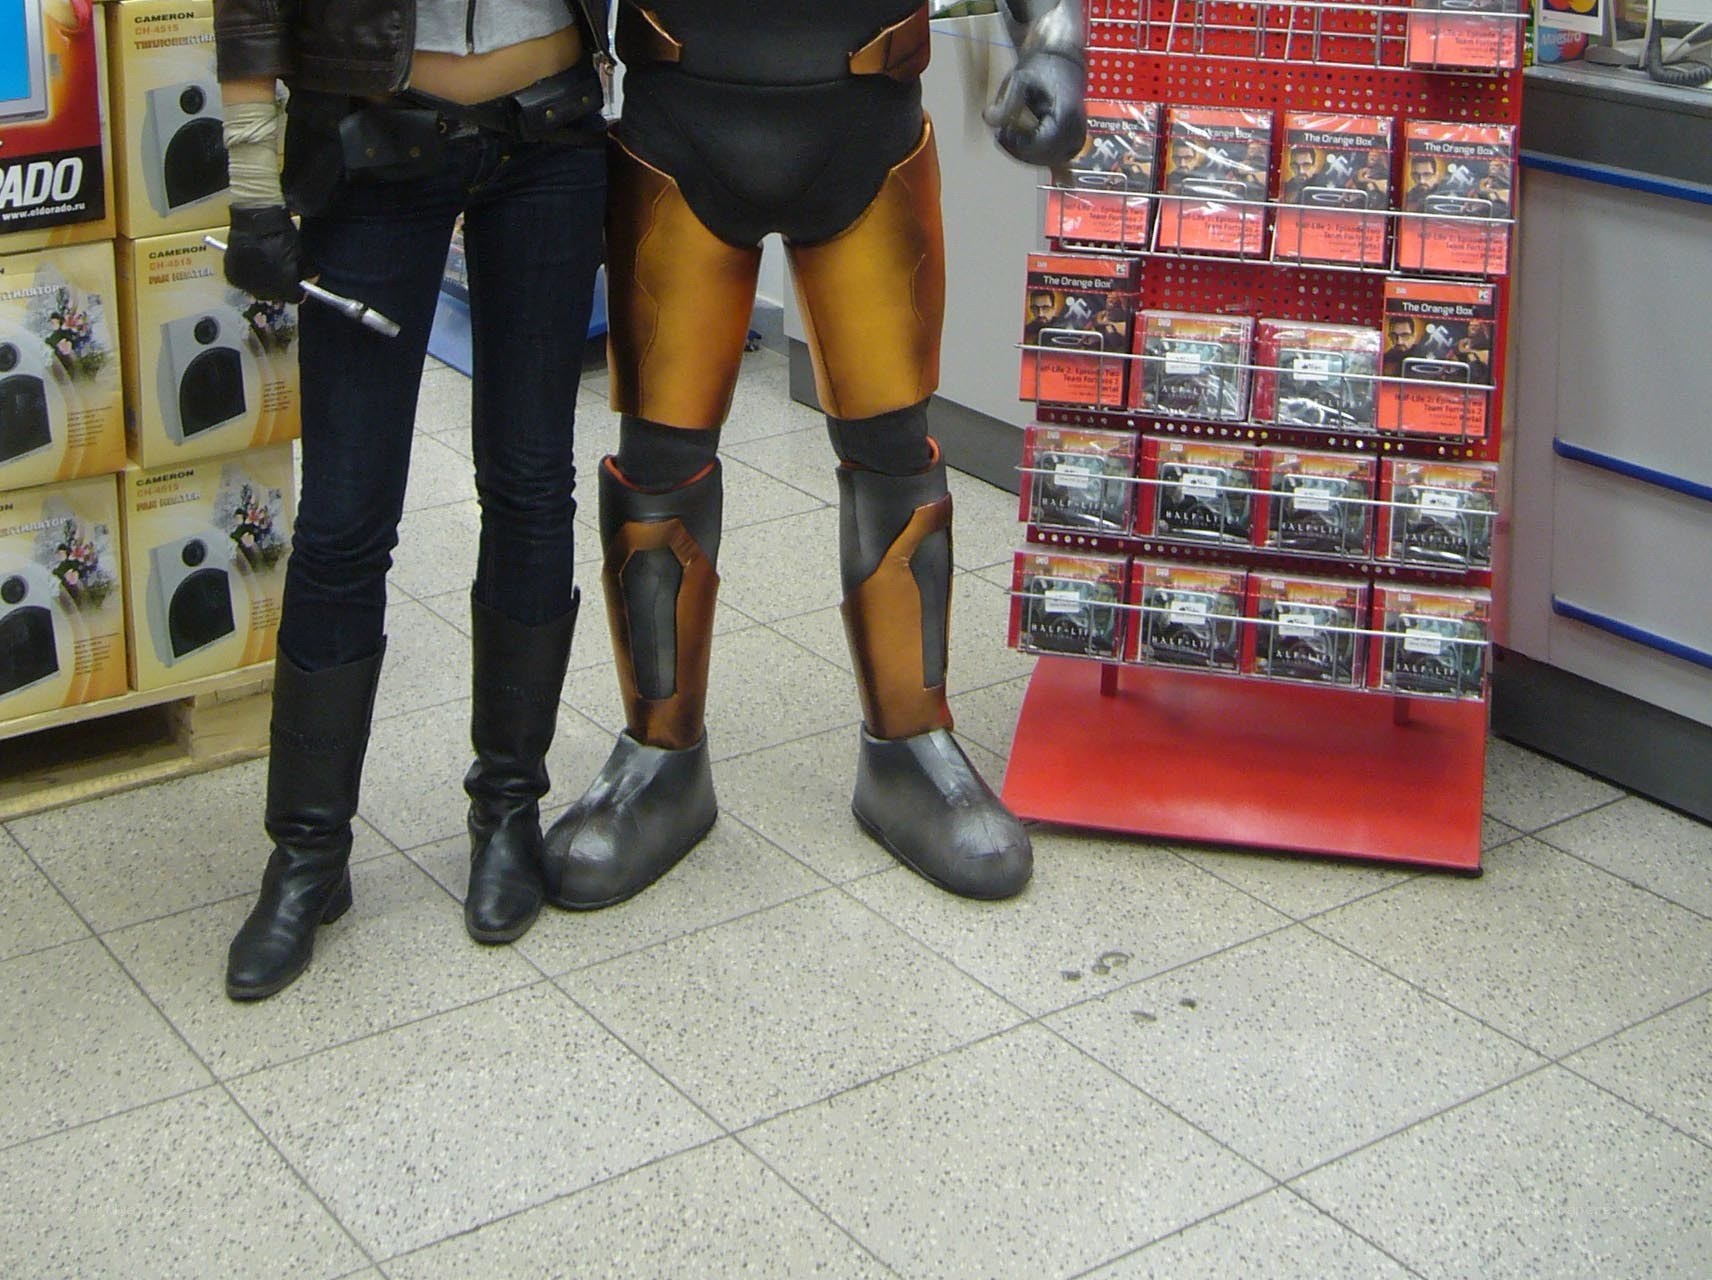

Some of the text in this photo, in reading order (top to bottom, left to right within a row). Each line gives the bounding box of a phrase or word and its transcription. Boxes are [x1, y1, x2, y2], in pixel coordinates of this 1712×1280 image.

[134, 12, 194, 24] CAMERON
[1304, 132, 1372, 146] The Orange Box
[1425, 142, 1493, 156] The Orange Box
[0, 157, 83, 210] ADO
[2, 203, 86, 221] www.eldorado.ru
[148, 245, 207, 259] CAMERON
[1043, 275, 1111, 289] The Orange Box
[1402, 302, 1473, 315] The Orange Box
[136, 469, 194, 486] CAMERON
